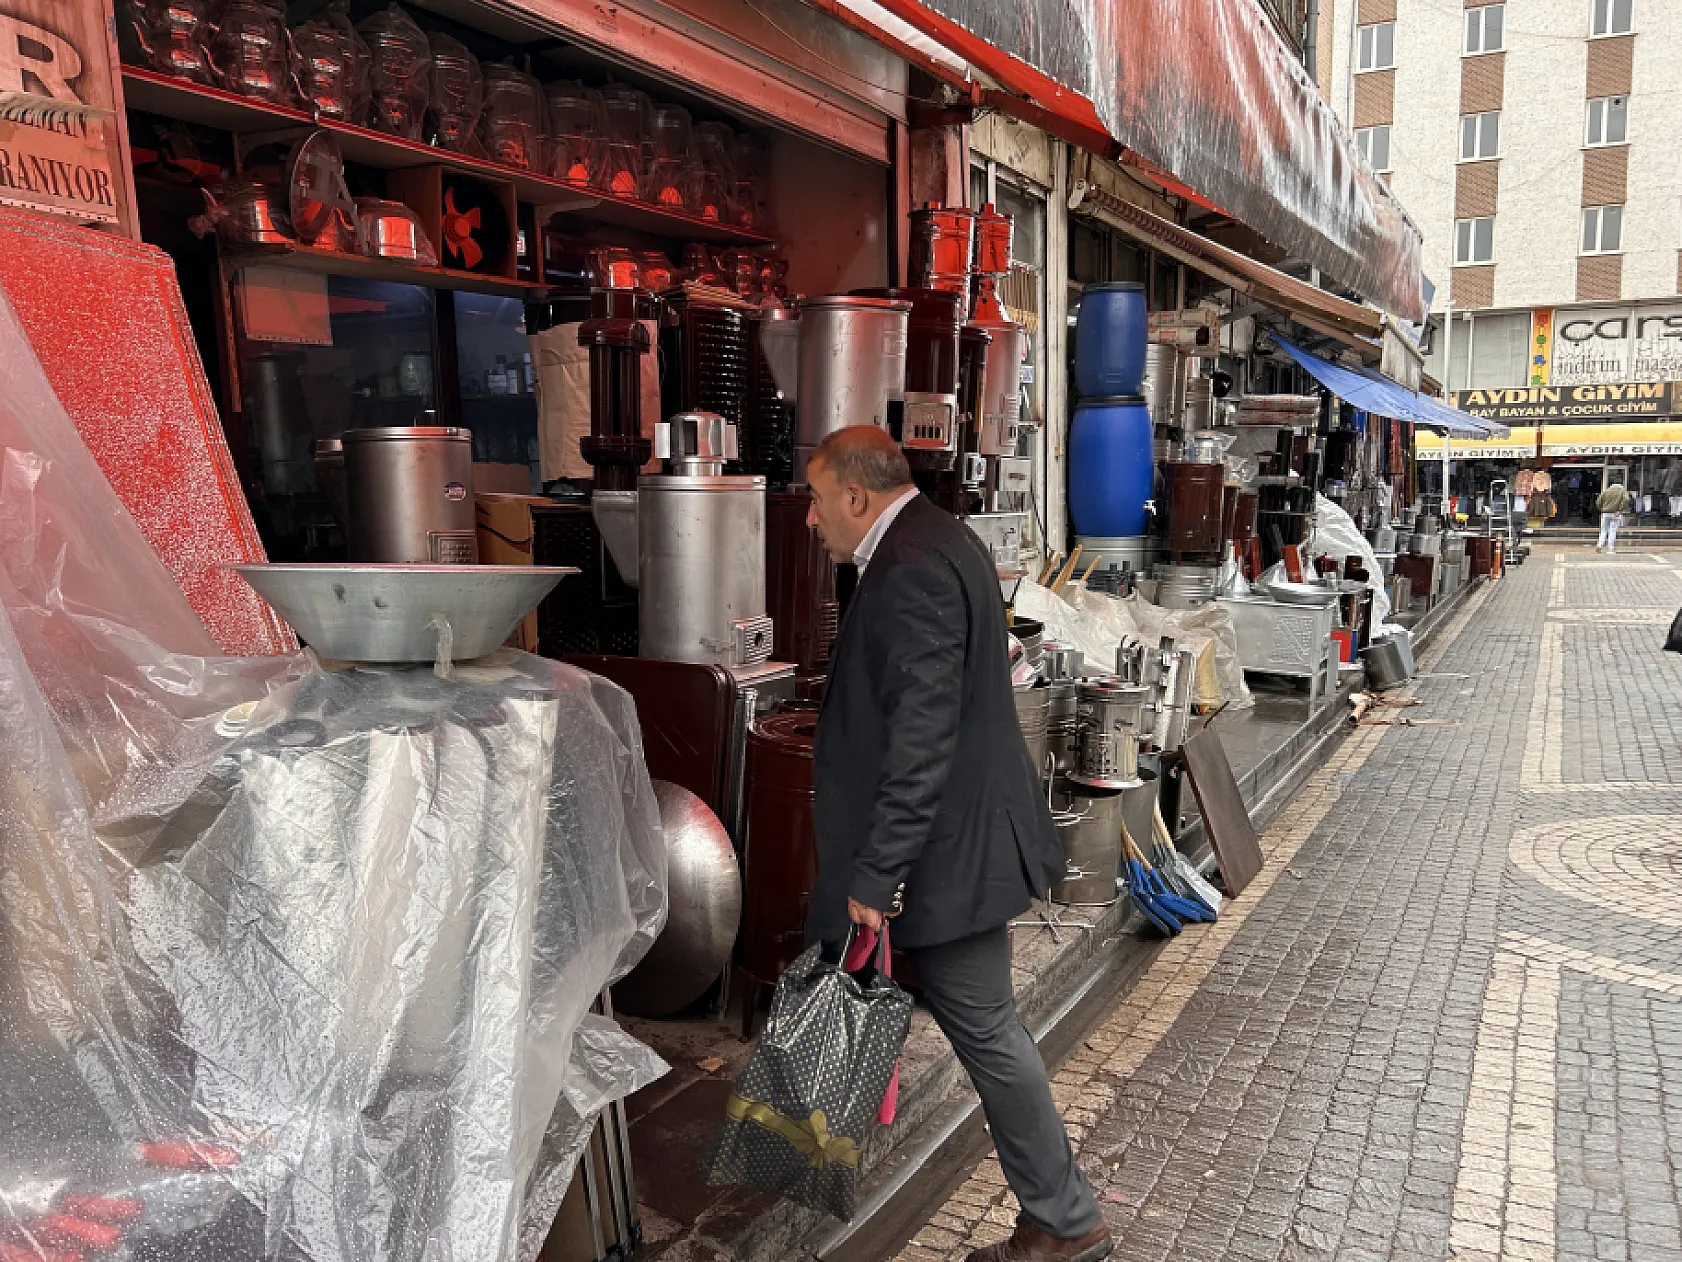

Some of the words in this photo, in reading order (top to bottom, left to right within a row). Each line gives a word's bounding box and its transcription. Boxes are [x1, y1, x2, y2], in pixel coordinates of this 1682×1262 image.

[0, 108, 87, 139] LEMAN
[0, 149, 112, 206] RANIYOR
[1465, 388, 1560, 405] AYDIN
[1470, 408, 1496, 417] BAY
[1499, 406, 1544, 417] BAYAN
[1547, 406, 1558, 415] &
[1561, 404, 1613, 417] ÇOCUK
